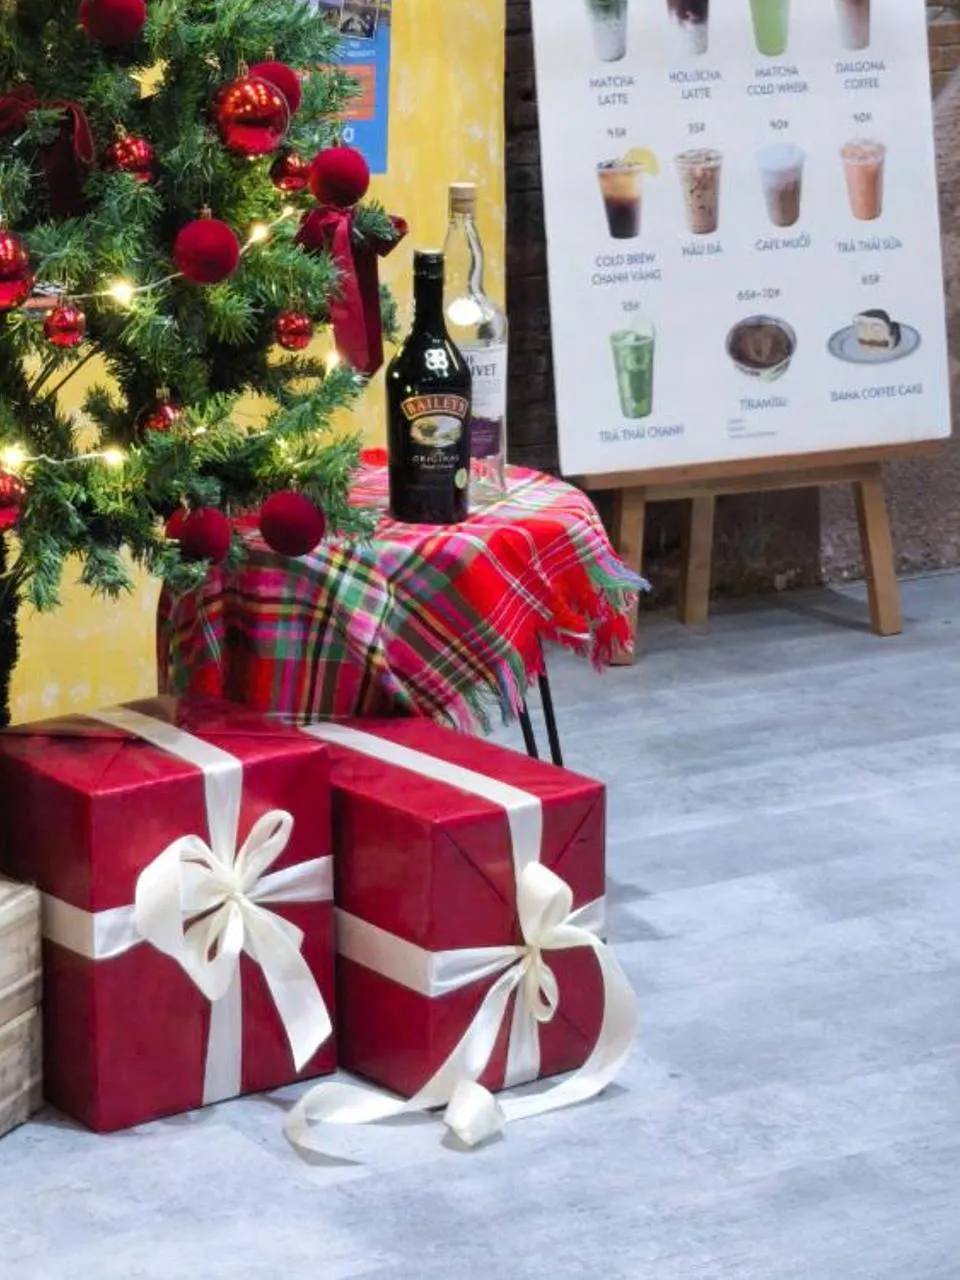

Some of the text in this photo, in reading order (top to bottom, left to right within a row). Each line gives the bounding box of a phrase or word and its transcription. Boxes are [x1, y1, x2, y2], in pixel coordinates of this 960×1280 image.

[755, 66, 799, 78] MATCHA
[589, 76, 635, 88] MATCHA
[844, 77, 880, 90] COFFEE
[598, 93, 628, 106] LATTE
[681, 87, 712, 100] LATTE
[595, 253, 656, 268] COLD BREW
[472, 363, 497, 376] IVET
[862, 386, 896, 399] COFFEE
[406, 397, 466, 415] BAILEYS
